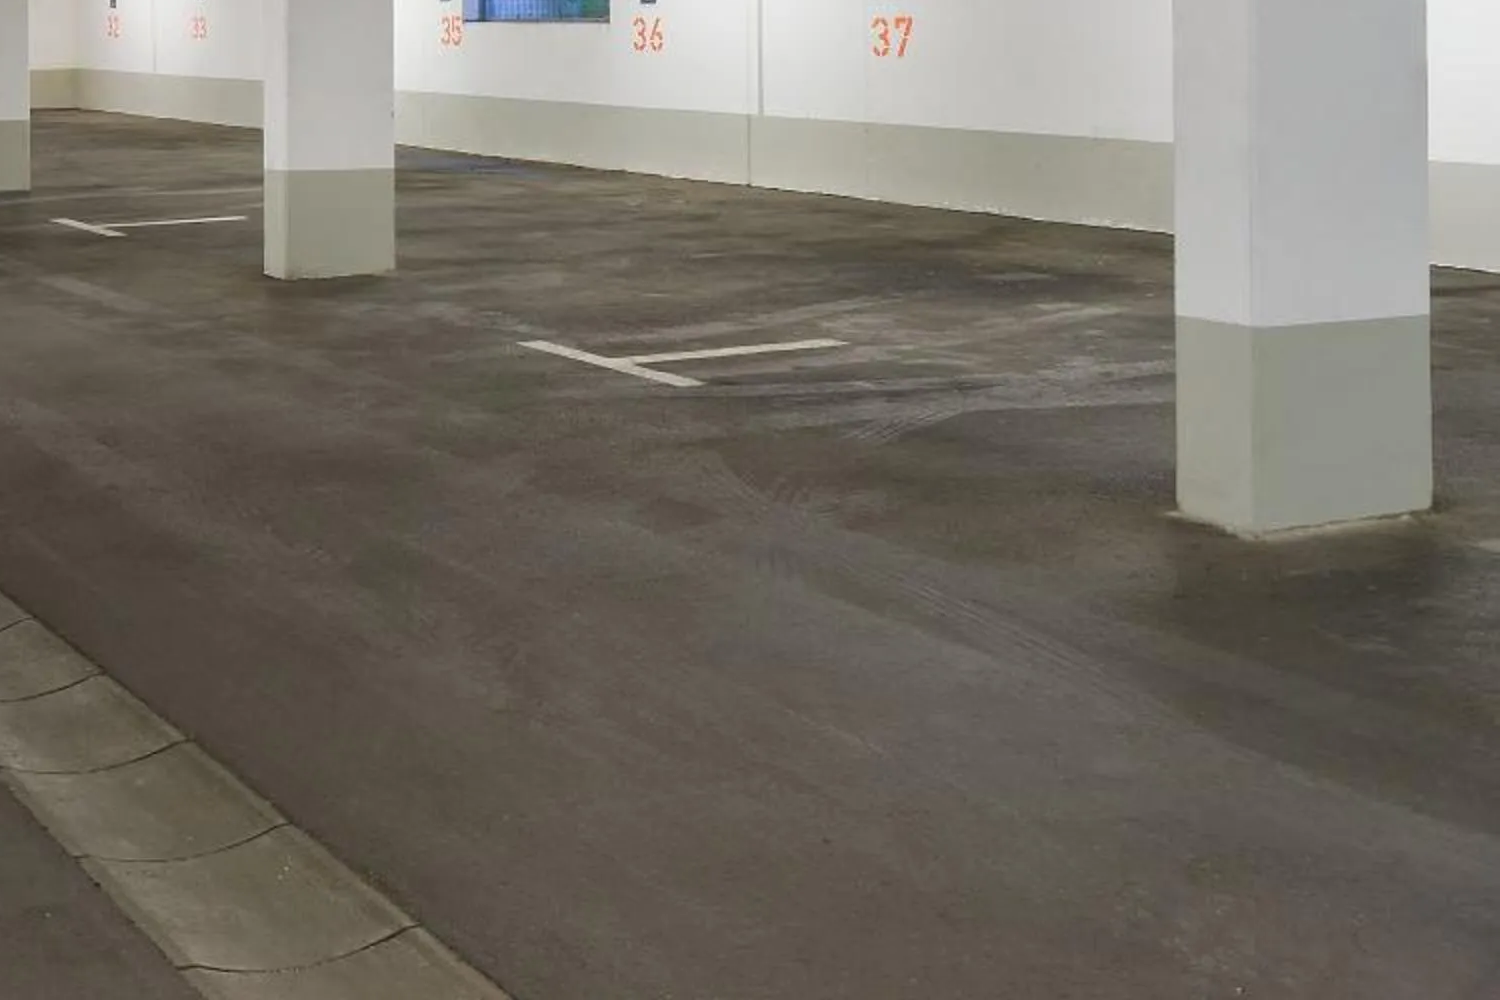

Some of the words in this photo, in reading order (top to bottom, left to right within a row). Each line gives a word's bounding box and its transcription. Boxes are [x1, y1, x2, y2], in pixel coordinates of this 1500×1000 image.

[441, 14, 462, 46] 35
[633, 17, 663, 52] 36
[870, 15, 913, 57] 37
